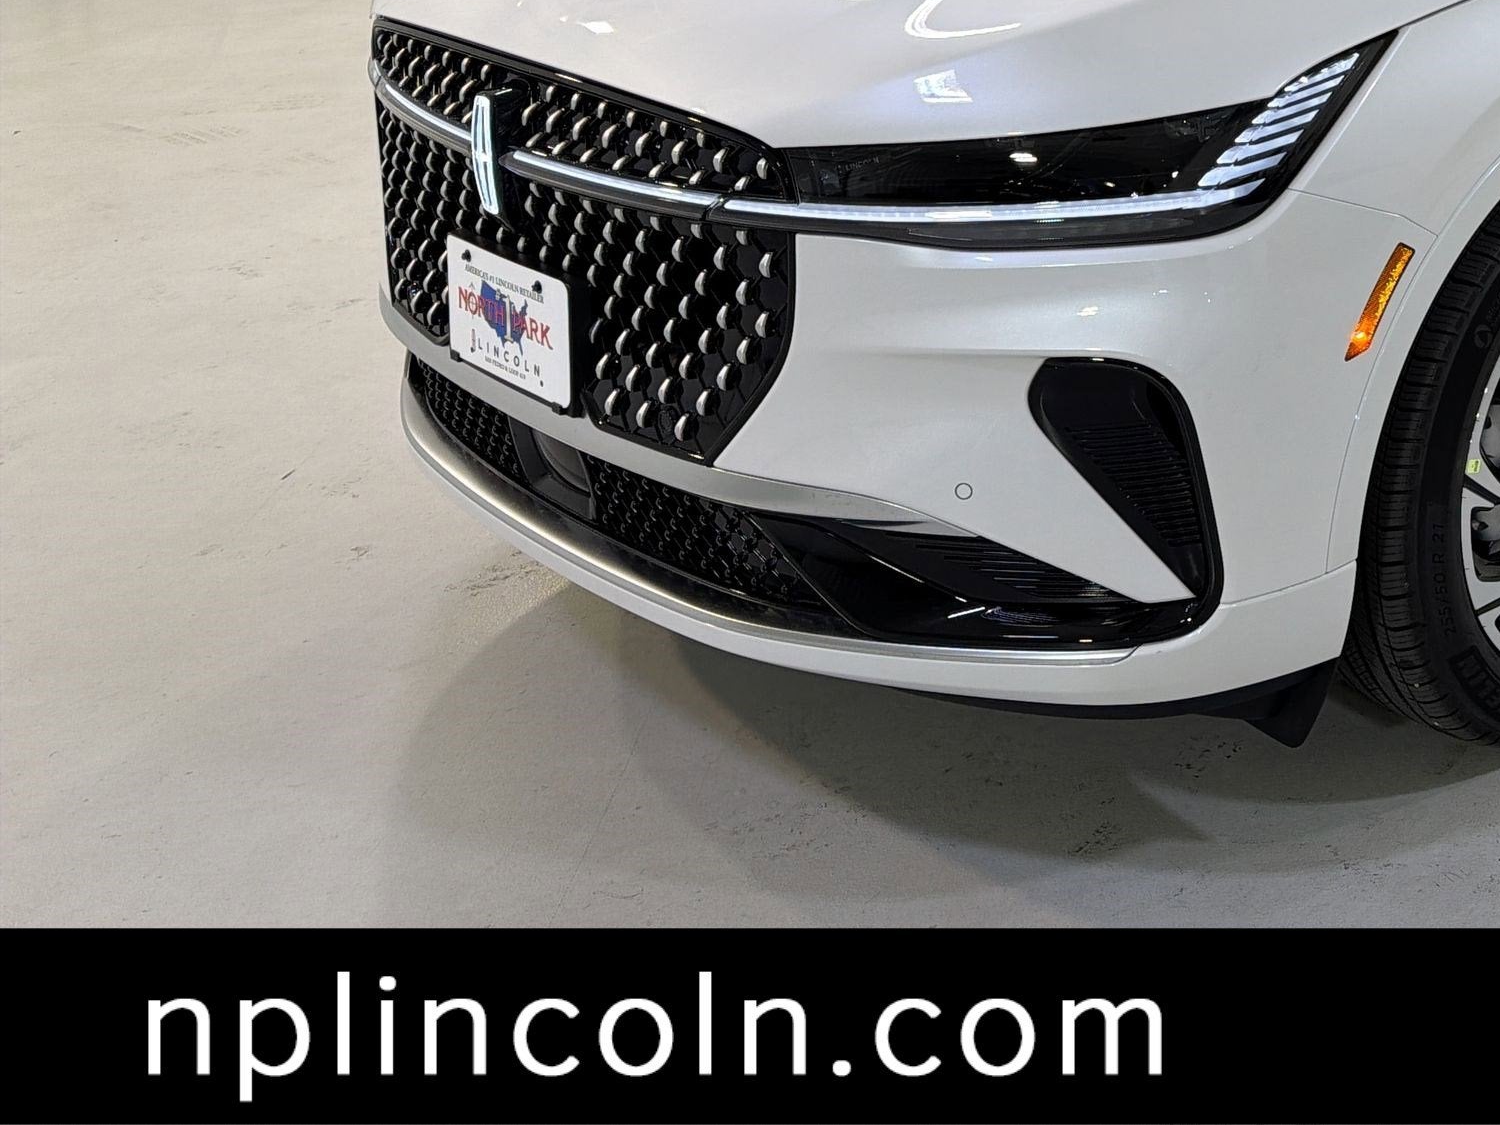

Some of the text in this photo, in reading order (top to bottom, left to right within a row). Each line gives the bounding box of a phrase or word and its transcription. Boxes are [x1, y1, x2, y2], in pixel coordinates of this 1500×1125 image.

[458, 286, 554, 350] NORTH PARK
[477, 338, 541, 378] LINCOLN
